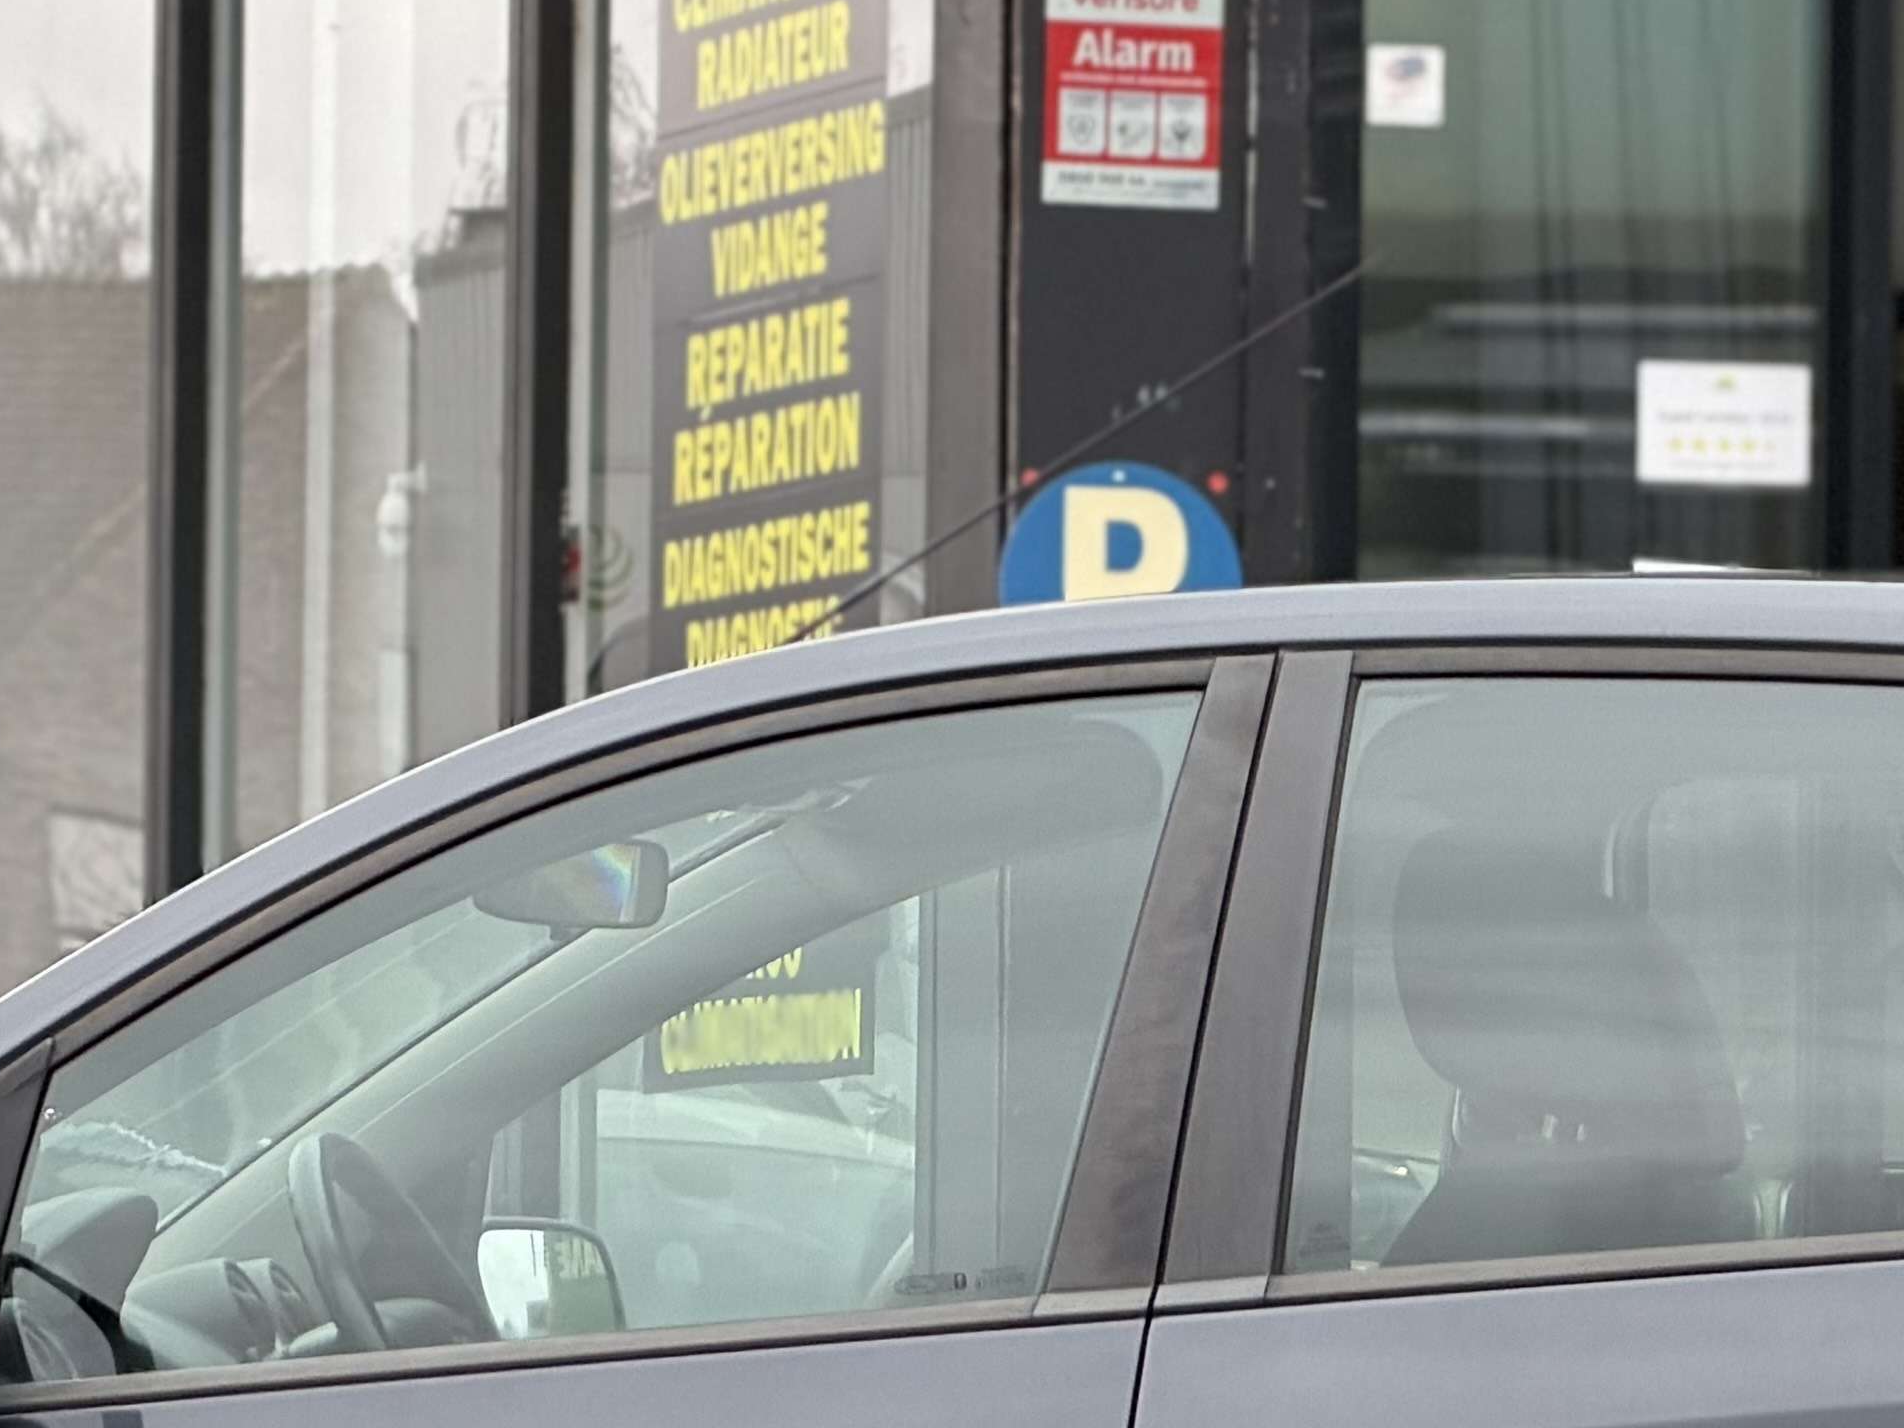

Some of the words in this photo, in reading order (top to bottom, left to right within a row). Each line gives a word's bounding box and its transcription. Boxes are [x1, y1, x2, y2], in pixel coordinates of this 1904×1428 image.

[1073, 28, 1195, 72] Alarm
[659, 100, 886, 225] OLIEVERVERSING
[711, 202, 829, 298] VIDANGE
[686, 298, 851, 409] REPARATIE
[673, 393, 861, 506] RÉPARATION
[662, 499, 872, 609] DIAGNOSTISCHE
